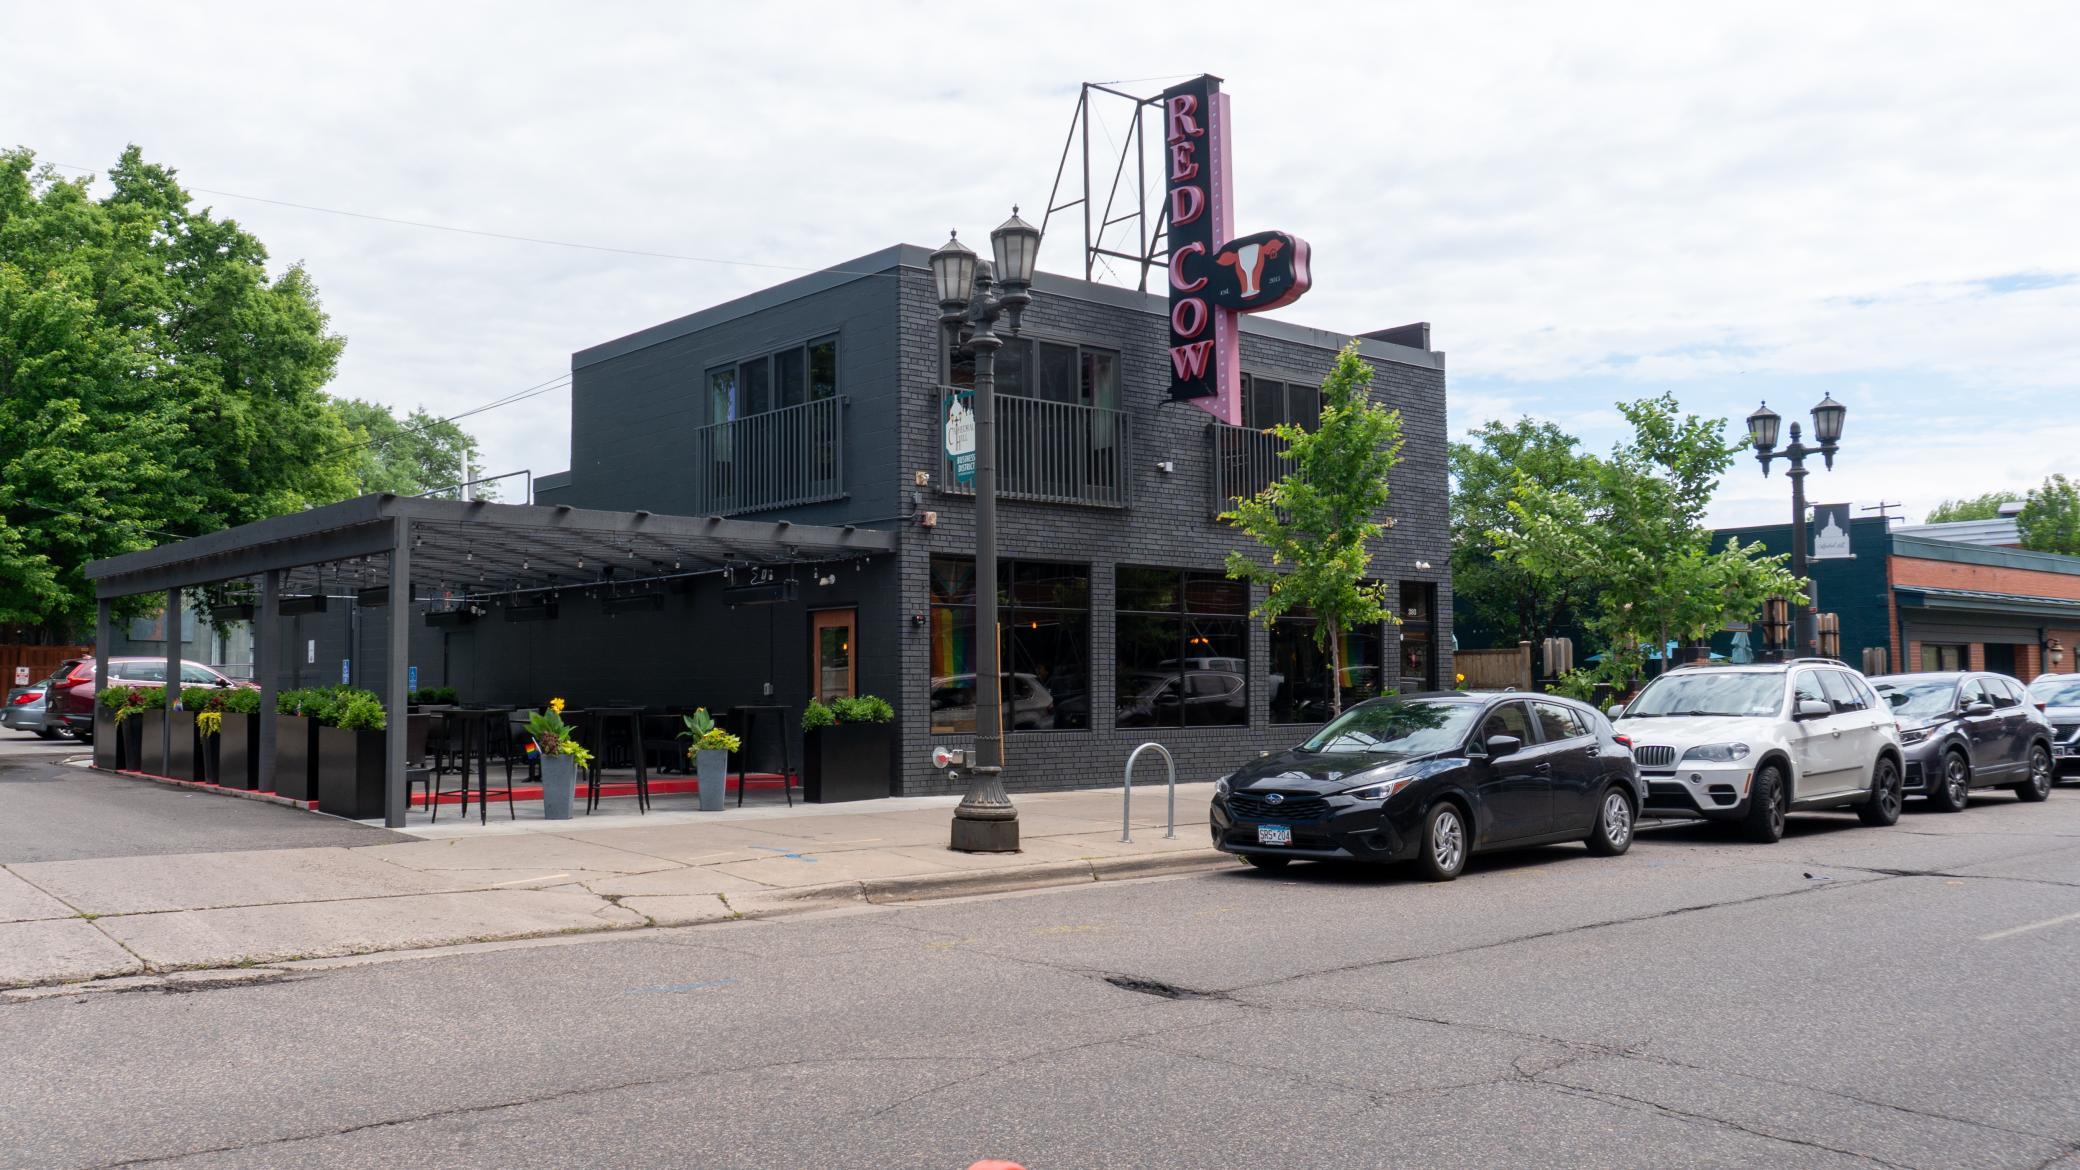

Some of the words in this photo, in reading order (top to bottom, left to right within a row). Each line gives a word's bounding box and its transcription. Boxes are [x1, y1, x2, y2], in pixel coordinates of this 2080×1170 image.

[1167, 94, 1204, 225] RED
[1169, 241, 1214, 381] COW
[957, 453, 976, 464] BUSINESS
[958, 462, 976, 473] DISTRICT
